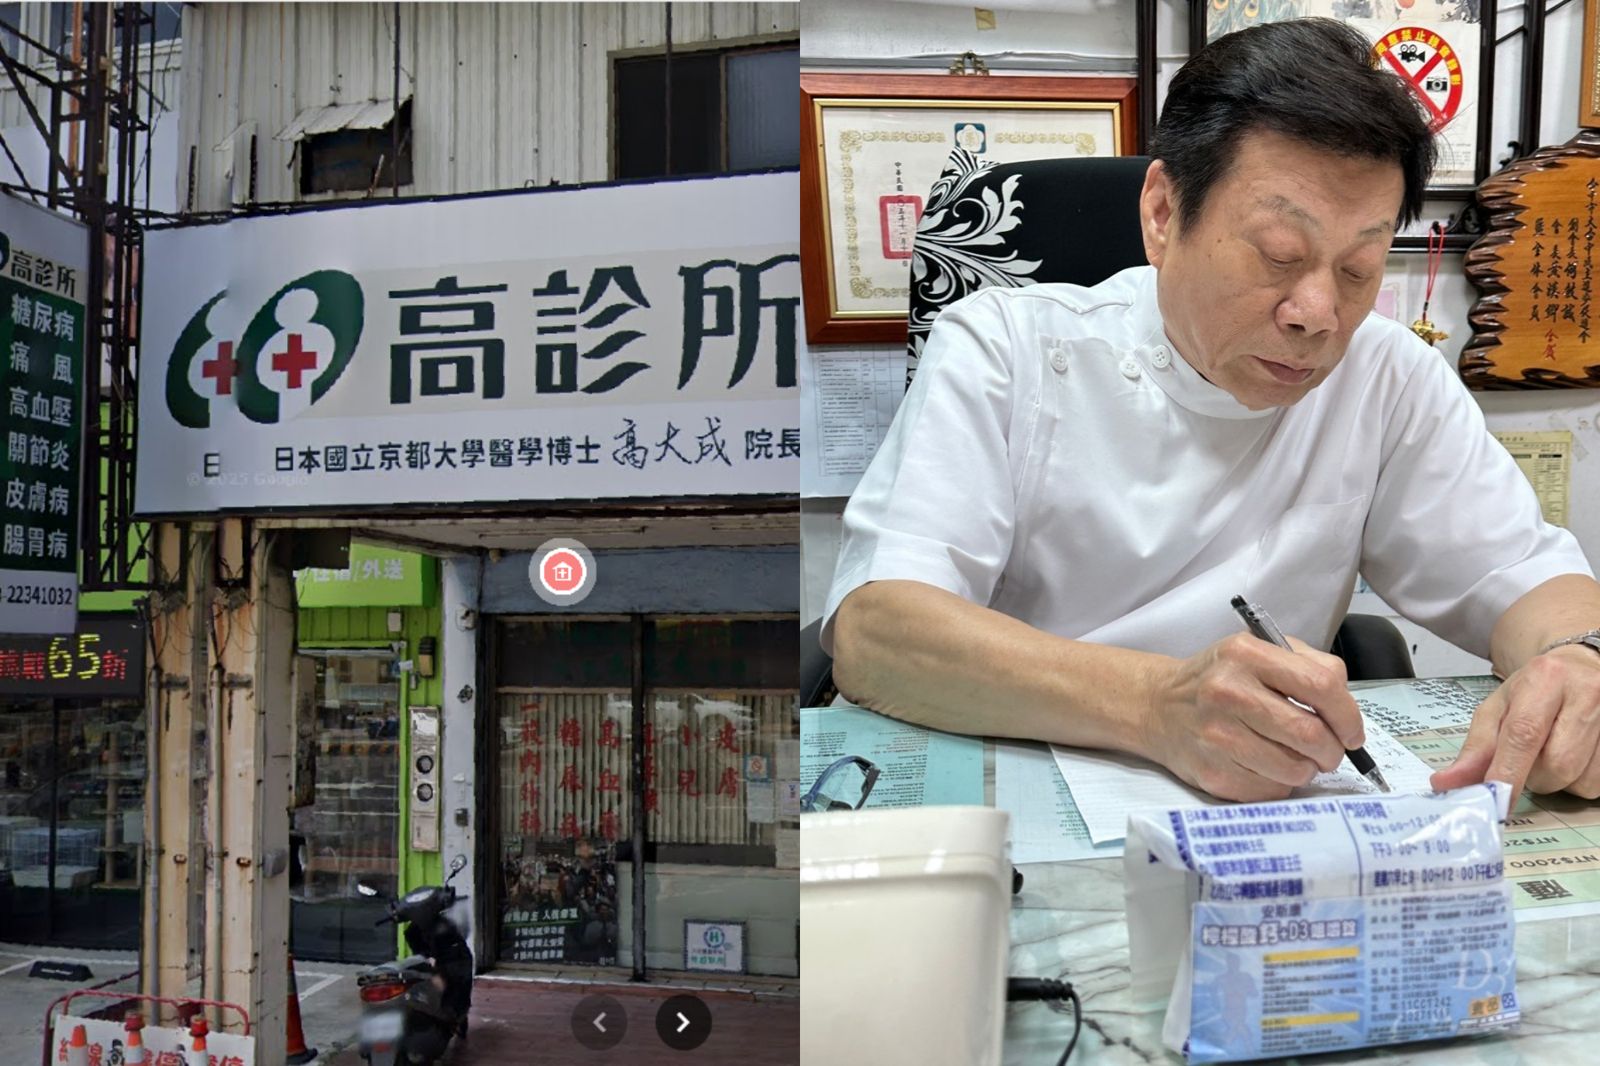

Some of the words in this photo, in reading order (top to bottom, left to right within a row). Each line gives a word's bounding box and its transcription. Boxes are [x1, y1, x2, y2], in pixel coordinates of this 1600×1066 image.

[11, 250, 76, 298] 高診所
[11, 292, 75, 341] 糖尿病
[388, 253, 800, 405] 高診所
[9, 386, 72, 427] 高血壓
[8, 430, 70, 472] 關節炎
[275, 435, 601, 474] 日本國立京都大學醫學博士
[745, 428, 800, 460] 院長
[6, 477, 69, 517] 皮膚病
[4, 523, 68, 559] 腸胃病
[0, 584, 73, 605] -22341032
[1510, 854, 1600, 869] NT$2000
